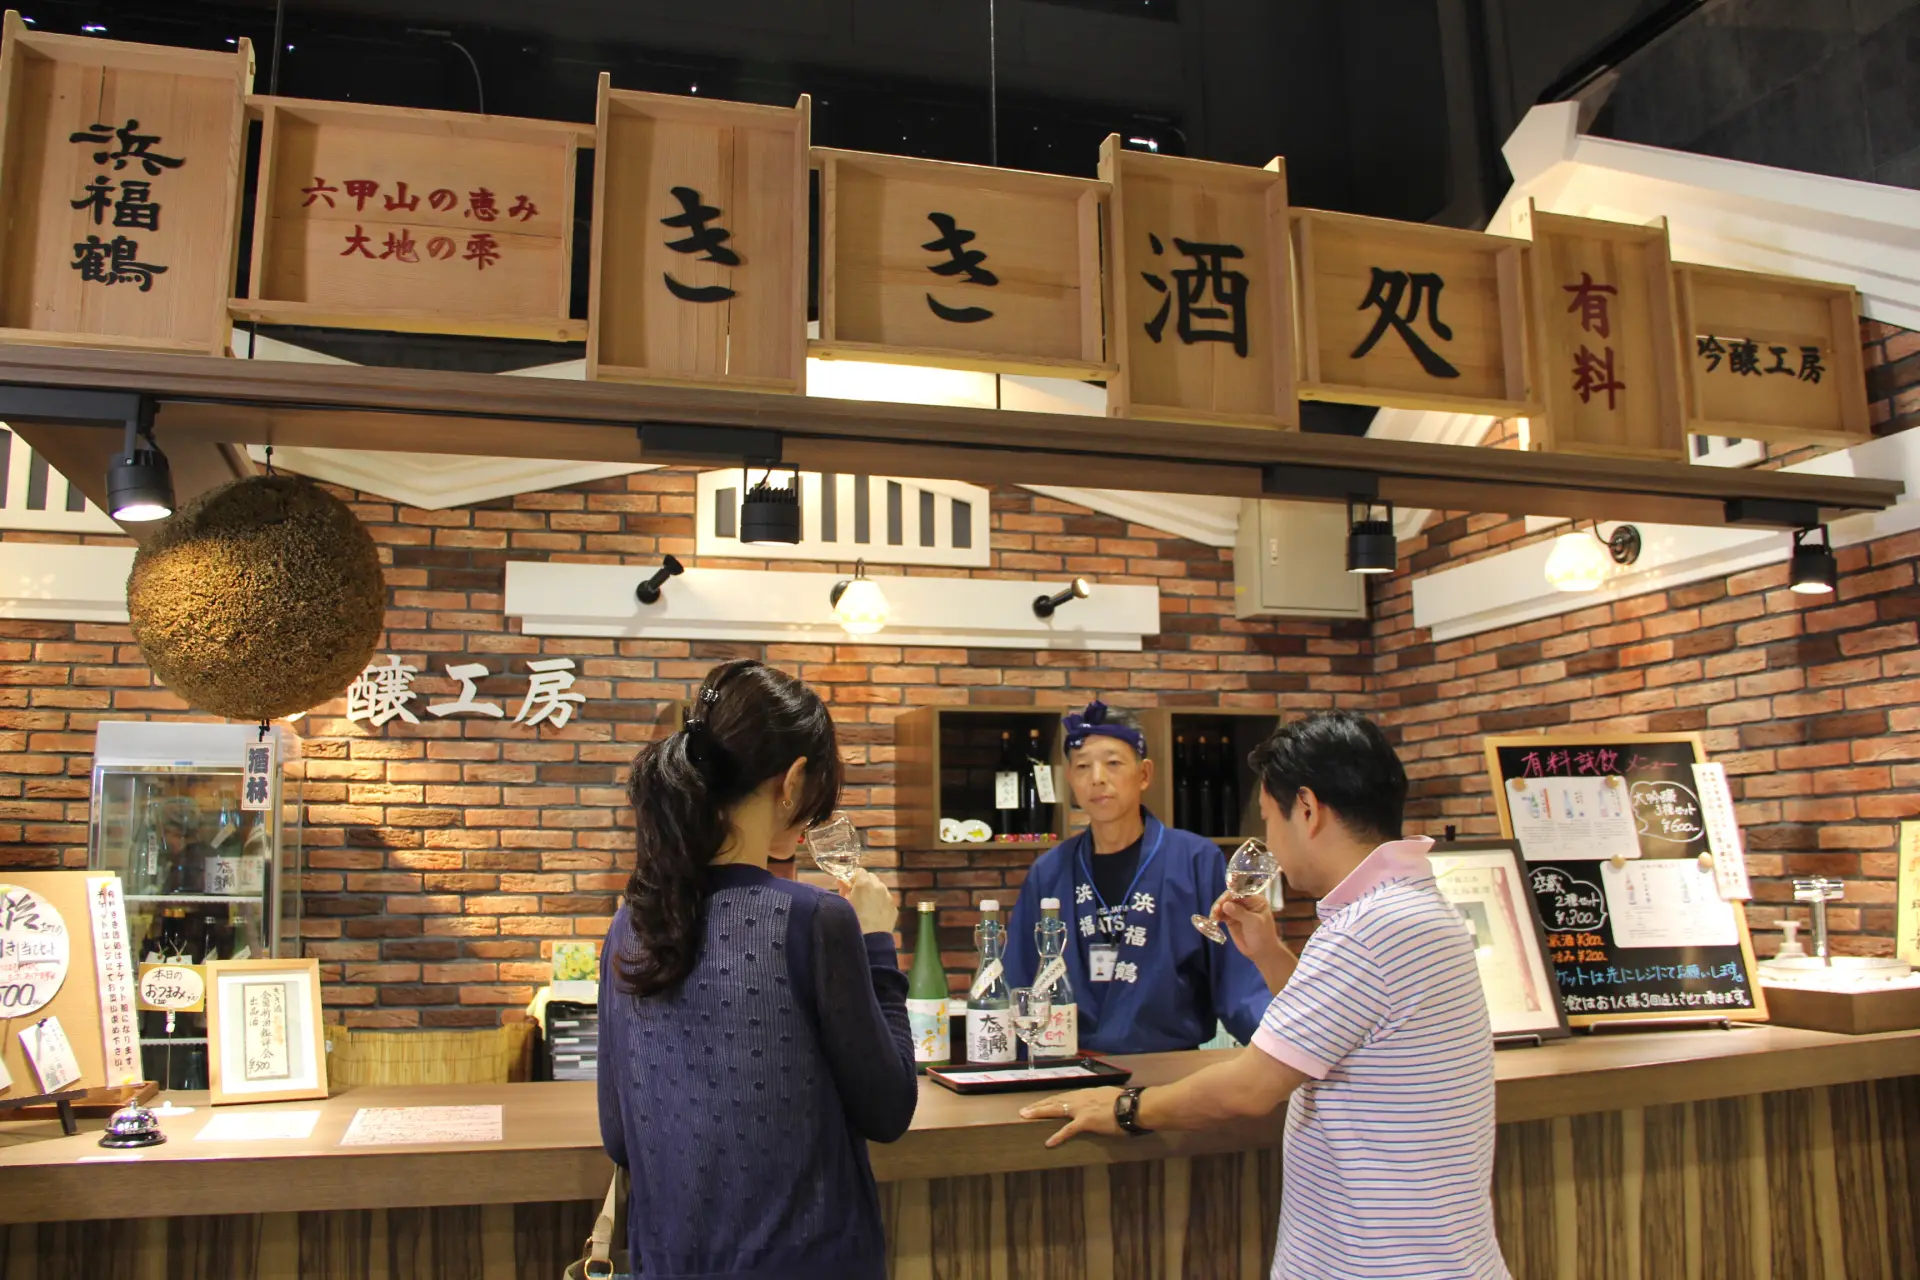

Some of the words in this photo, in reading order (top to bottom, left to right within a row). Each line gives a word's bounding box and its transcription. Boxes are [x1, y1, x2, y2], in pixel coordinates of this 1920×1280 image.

[69, 119, 187, 293] 浜福鶴
[301, 177, 541, 224] 六甲山の恵み
[340, 226, 502, 271] 大地の雫
[1561, 271, 1626, 411] 有料
[1696, 333, 1827, 385] 吟醸工房
[287, 654, 587, 729] 醸工房
[246, 747, 270, 804] 酒林
[1520, 748, 1623, 777] 有料試飲
[1626, 753, 1678, 773] メニュー
[1114, 891, 1156, 983] 浜福鶴
[145, 983, 186, 999] おつまみ
[152, 968, 183, 980] 本日の
[1556, 961, 1745, 987] ケットは先にレジにてお願いします。
